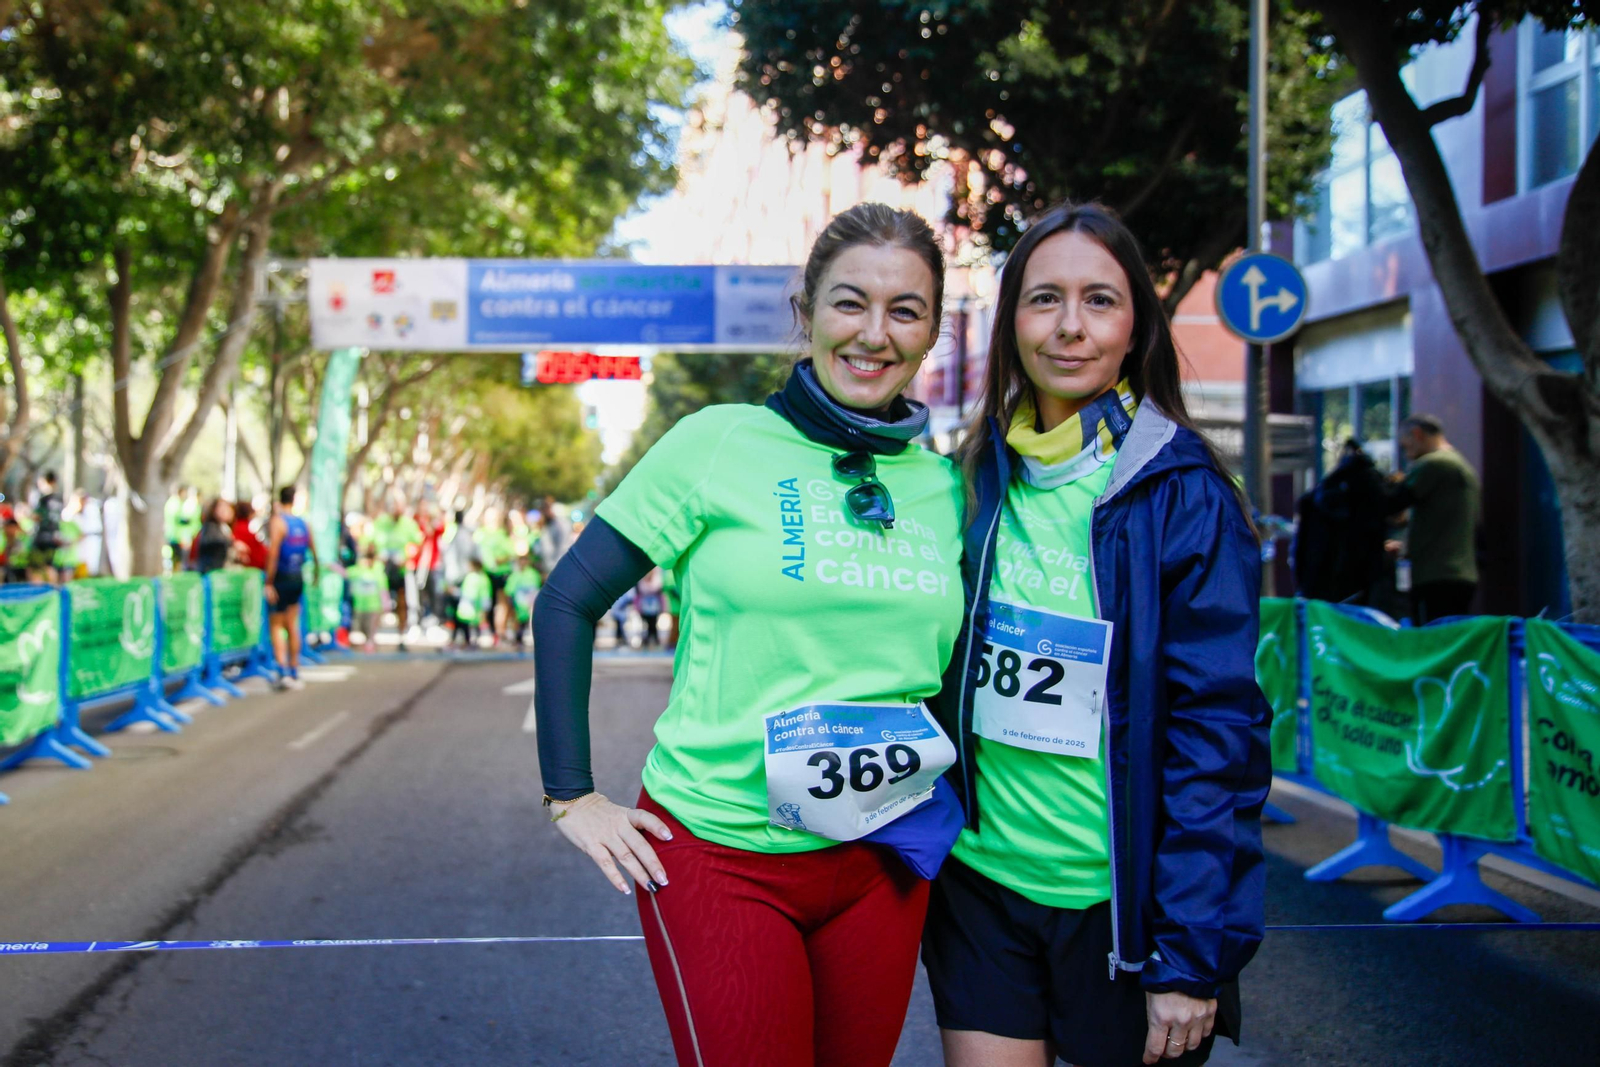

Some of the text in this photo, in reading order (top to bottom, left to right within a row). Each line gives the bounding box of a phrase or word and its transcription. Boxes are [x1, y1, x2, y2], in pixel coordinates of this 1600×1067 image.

[480, 269, 574, 291] Almería
[480, 298, 673, 318] contra el cáncer
[810, 505, 846, 524] En
[773, 477, 805, 582] ALMERÍA
[814, 527, 945, 565] contra el
[815, 552, 950, 597] cáncer
[998, 558, 1044, 589] ntra
[1049, 573, 1081, 601] el
[988, 617, 1026, 637] el cáncer
[773, 710, 821, 730] Almería
[774, 723, 864, 742] contra el cáncer
[1002, 728, 1086, 749] 9 de febrero de 2025
[806, 743, 921, 800] 369
[864, 816, 870, 824] 9
[869, 811, 878, 821] de
[878, 800, 899, 816] febrero
[898, 796, 907, 804] de
